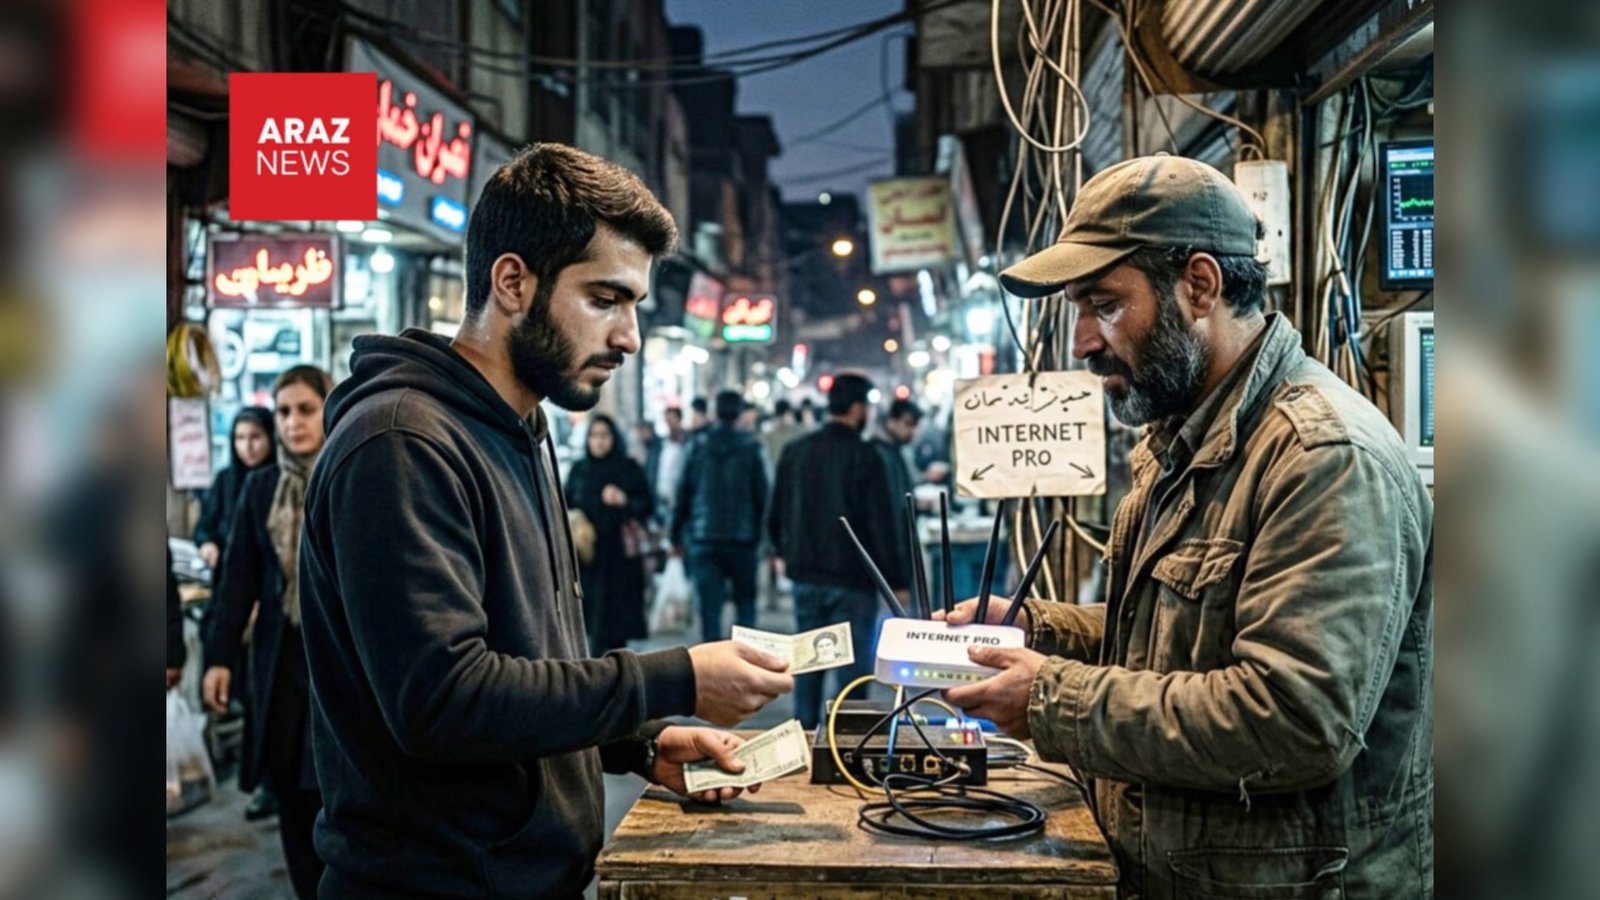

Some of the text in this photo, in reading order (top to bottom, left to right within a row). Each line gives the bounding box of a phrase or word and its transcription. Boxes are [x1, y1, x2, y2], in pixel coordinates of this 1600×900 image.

[978, 422, 1087, 444] INTERNET
[1012, 449, 1052, 467] PRO
[907, 631, 1000, 645] INTERNET PRO
